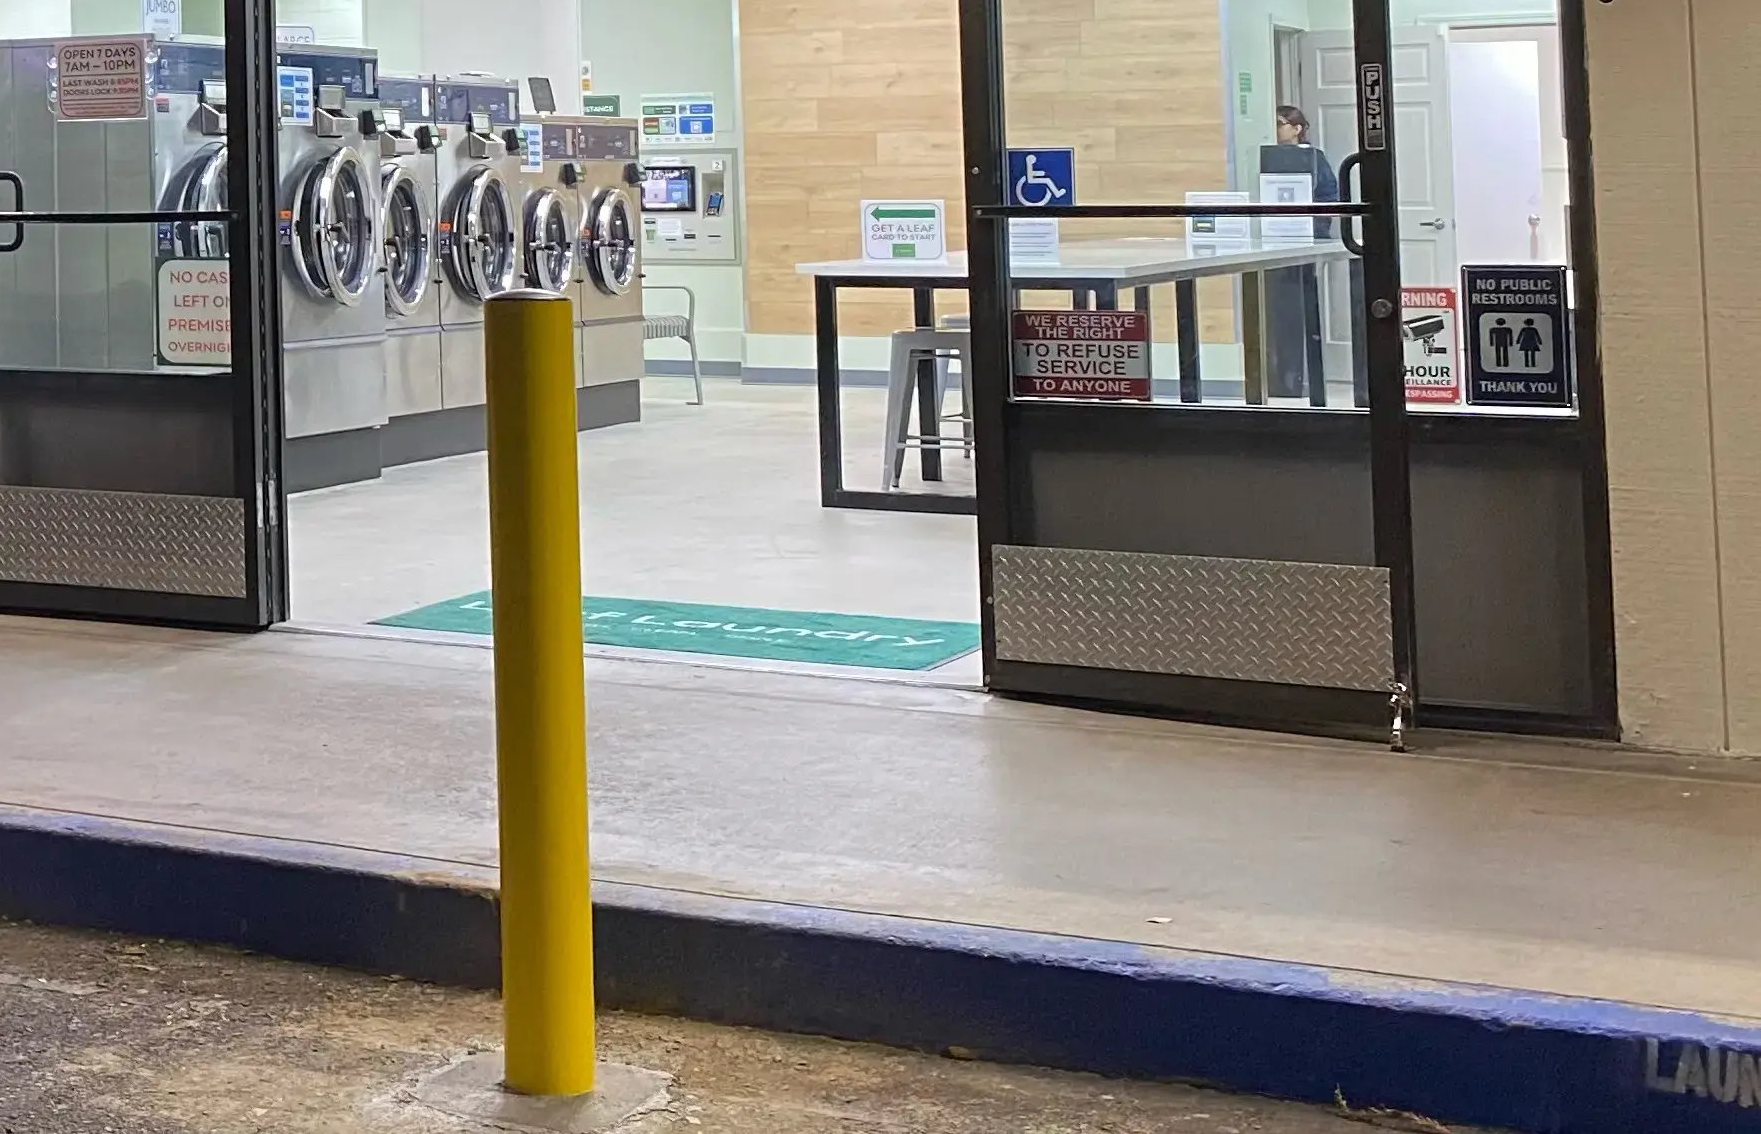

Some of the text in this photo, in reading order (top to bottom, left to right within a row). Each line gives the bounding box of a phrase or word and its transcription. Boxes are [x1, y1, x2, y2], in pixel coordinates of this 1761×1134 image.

[146, 0, 176, 16] JUMBO
[63, 47, 136, 60] OPEN 7 DAYS
[65, 61, 90, 73] 7AM
[103, 59, 136, 71] 10PM
[63, 79, 83, 88] LAST
[84, 77, 109, 87] WASH
[1365, 70, 1382, 129] PUSH
[871, 223, 935, 233] GET A LEAF
[871, 233, 936, 241] CARD TO START
[170, 270, 228, 285] NO CAS
[1476, 278, 1553, 291] NO PUBLIC
[174, 294, 210, 308] LEFT
[1471, 293, 1558, 306] RESTROOMS
[1025, 315, 1136, 328] WE RESERVE
[1035, 326, 1125, 340] THE RIGHT
[168, 341, 231, 353] OVERNIG
[1021, 342, 1140, 359] TO REFUSE
[1036, 359, 1127, 376] SERVICE
[1404, 365, 1451, 378] HOUR
[1033, 378, 1132, 393] TO ANYONE
[1478, 380, 1558, 394] THANK YOU
[630, 615, 946, 647] Laundry
